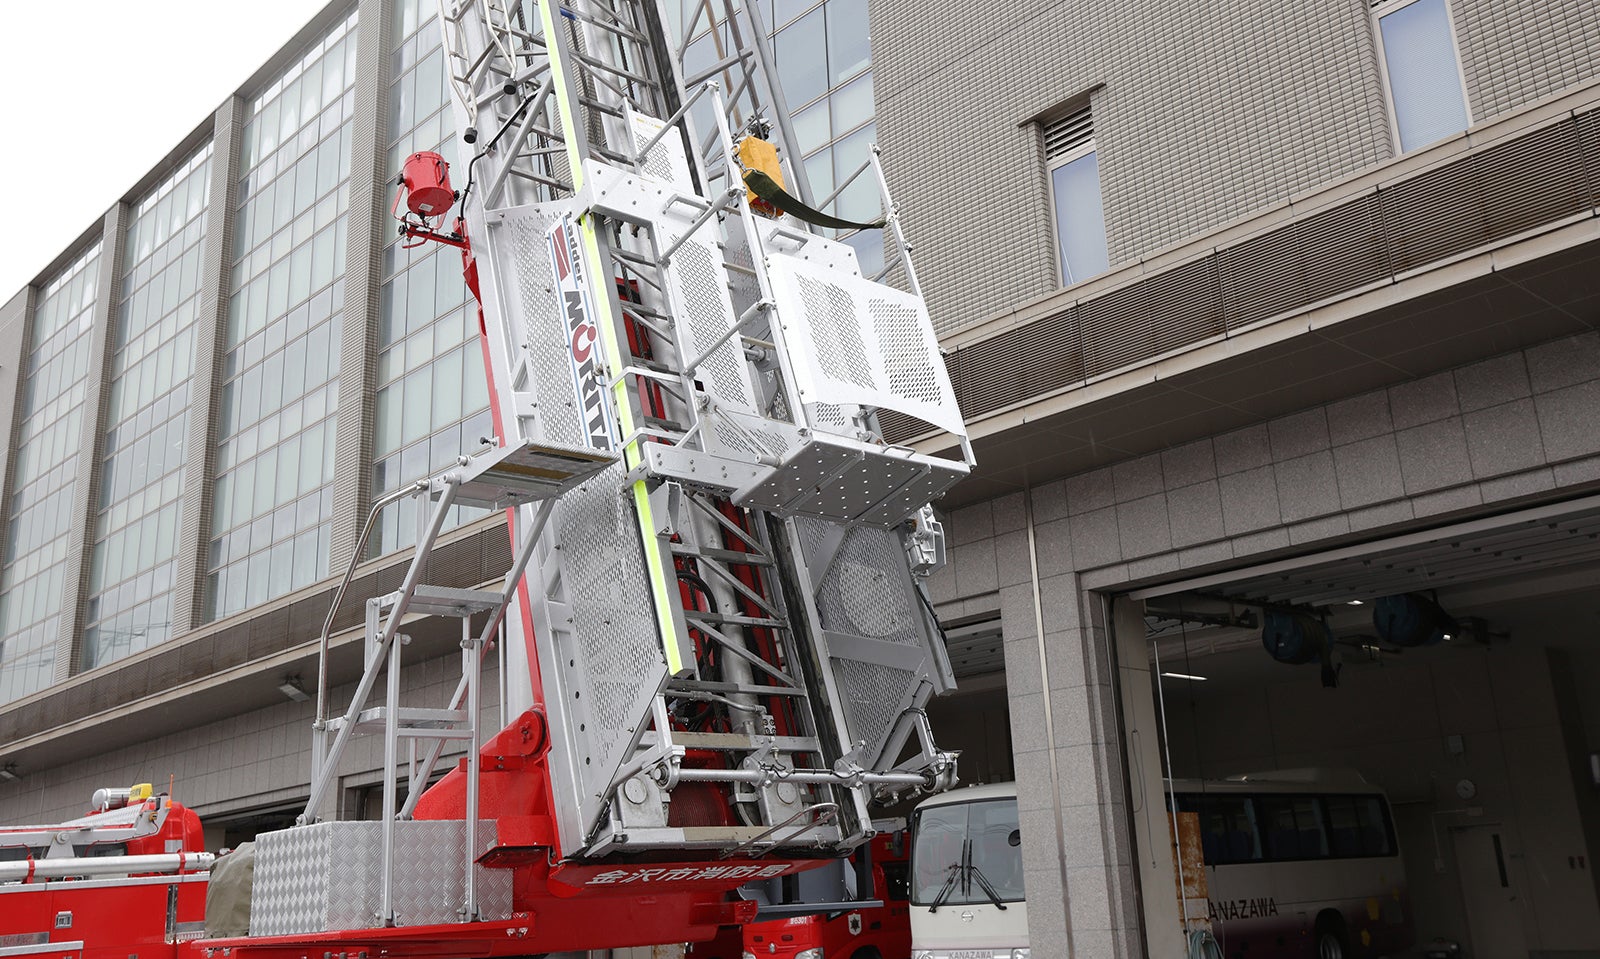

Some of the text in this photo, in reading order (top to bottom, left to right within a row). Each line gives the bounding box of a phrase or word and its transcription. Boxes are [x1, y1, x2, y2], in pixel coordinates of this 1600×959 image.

[565, 211, 583, 284] Ladder
[585, 863, 791, 884] 金沢市消防局
[949, 951, 992, 959] KANAZAWA
